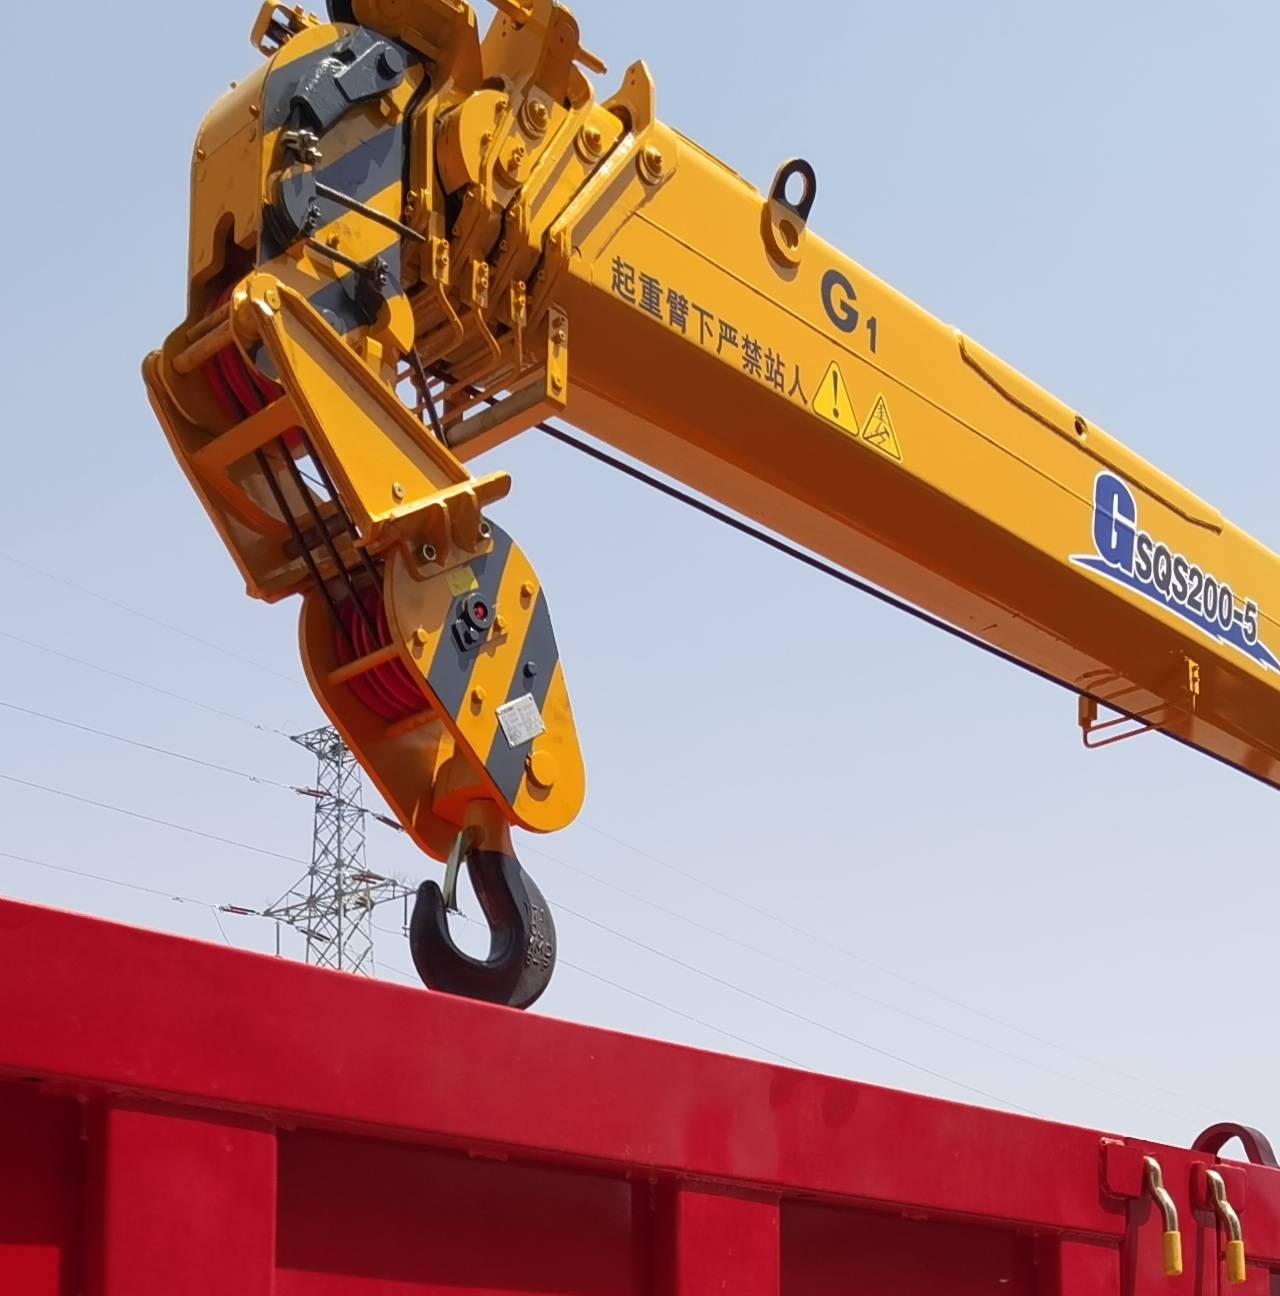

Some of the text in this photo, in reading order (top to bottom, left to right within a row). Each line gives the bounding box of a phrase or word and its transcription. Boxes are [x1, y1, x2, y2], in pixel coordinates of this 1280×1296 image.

[611, 256, 808, 405] 起重臂下严禁站人
